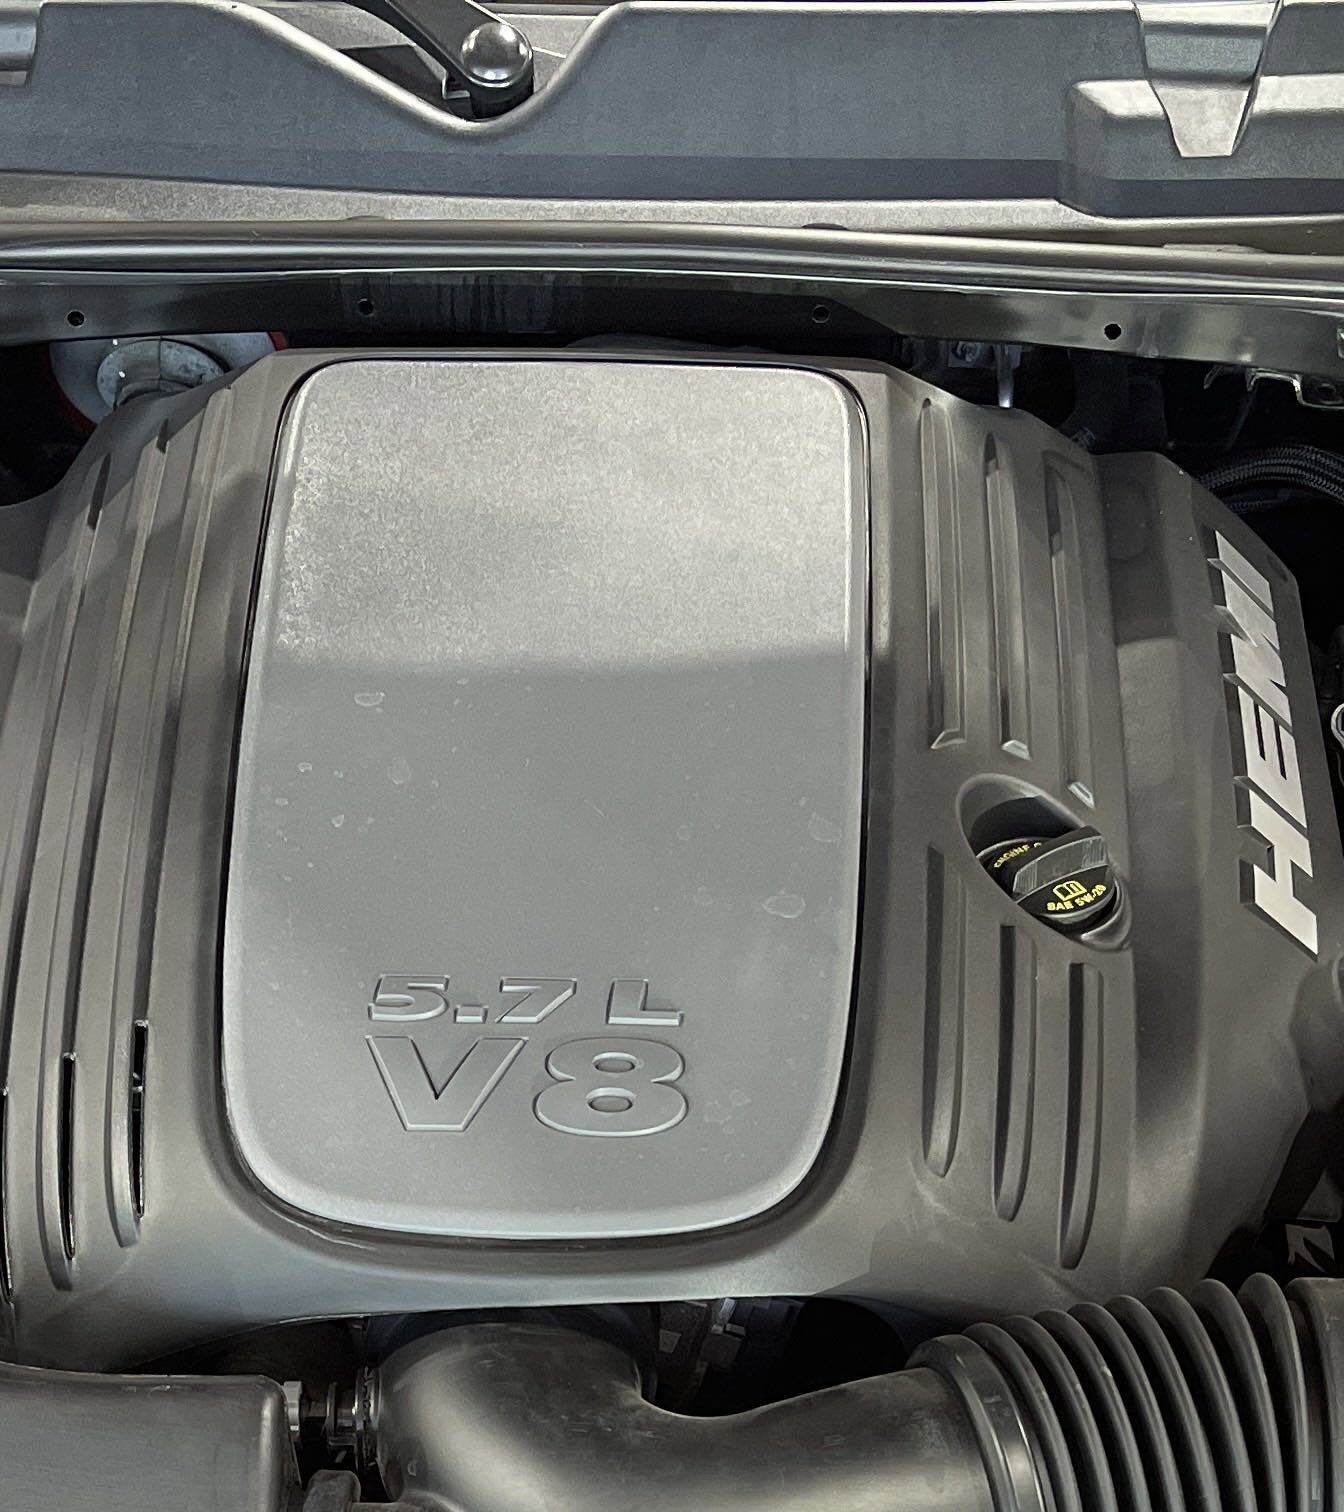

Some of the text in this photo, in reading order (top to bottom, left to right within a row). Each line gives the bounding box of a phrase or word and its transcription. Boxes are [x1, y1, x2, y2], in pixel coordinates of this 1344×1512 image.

[1212, 529, 1320, 956] HEMI
[1047, 901, 1074, 911] SAE
[368, 974, 684, 1026] 5.7 L
[364, 1036, 688, 1137] V8
